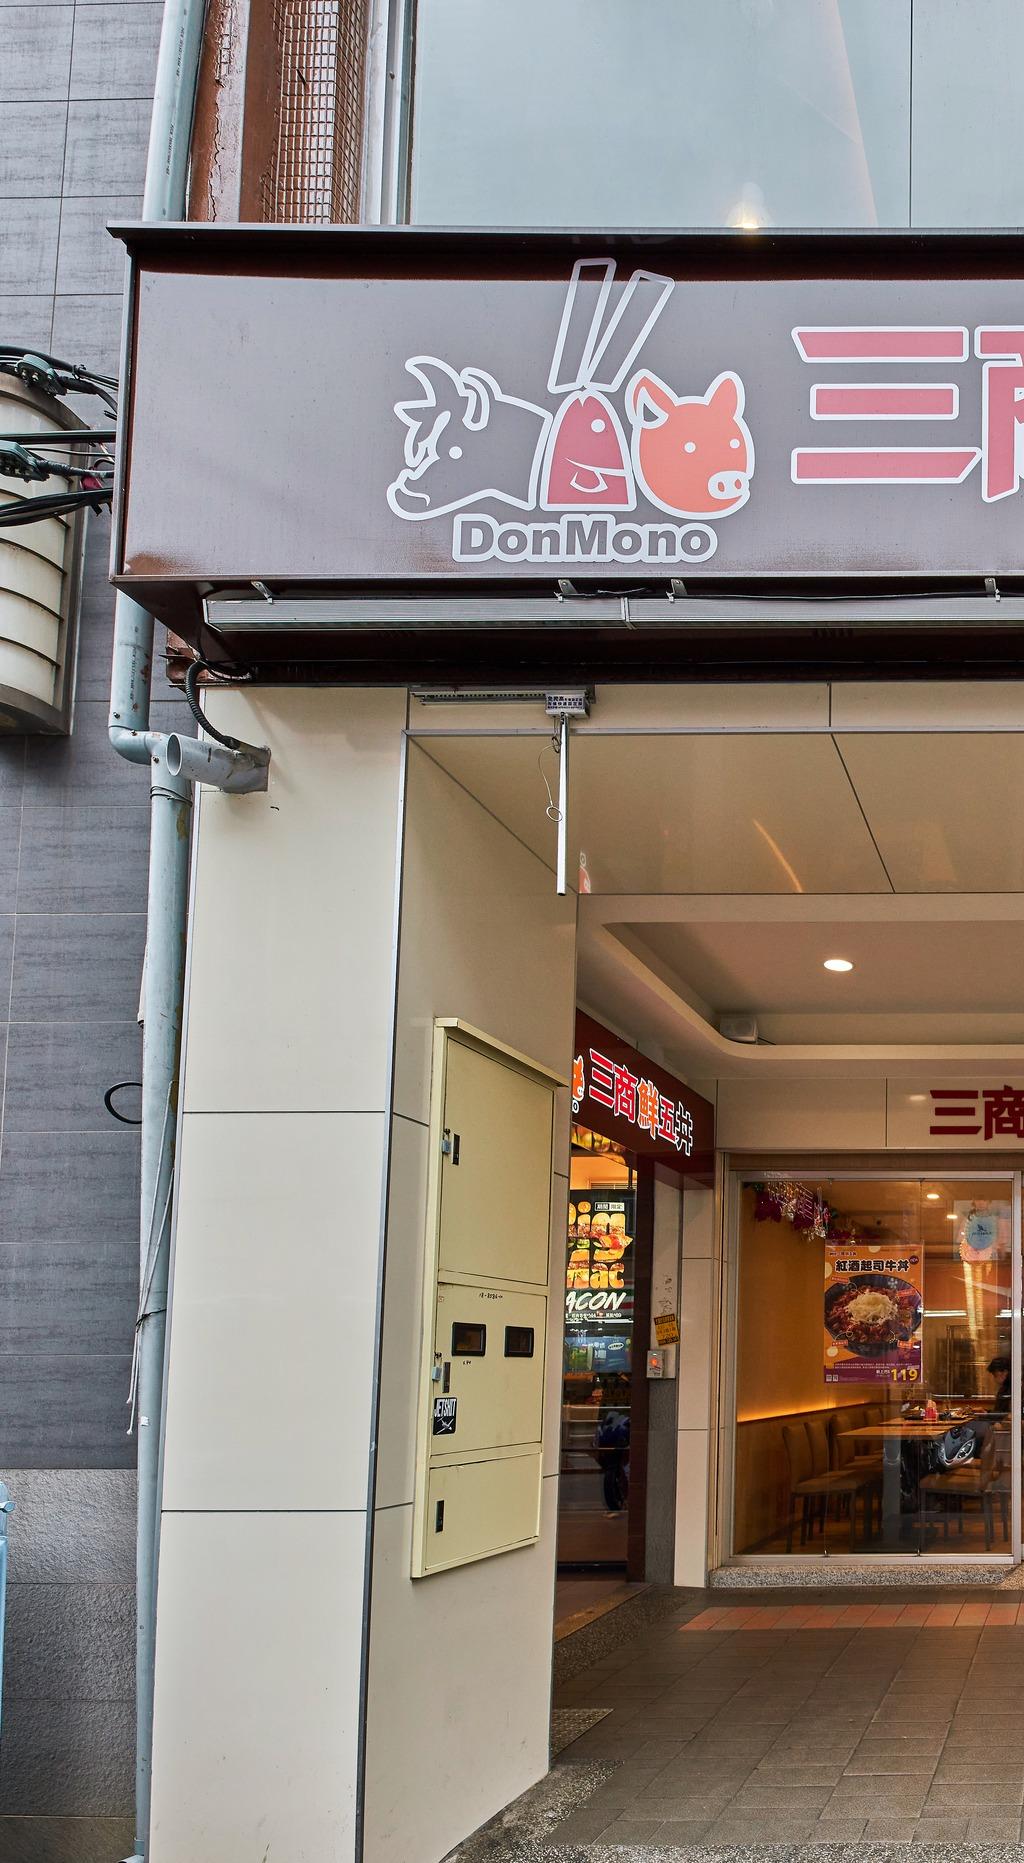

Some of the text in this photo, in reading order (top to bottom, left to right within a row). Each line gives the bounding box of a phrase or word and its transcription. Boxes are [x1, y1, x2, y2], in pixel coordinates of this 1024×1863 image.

[453, 513, 717, 563] DonMono
[588, 1048, 693, 1157] 三商鮮五丼
[835, 1259, 910, 1273] 紅酒起司牛丼
[891, 1368, 918, 1381] 119
